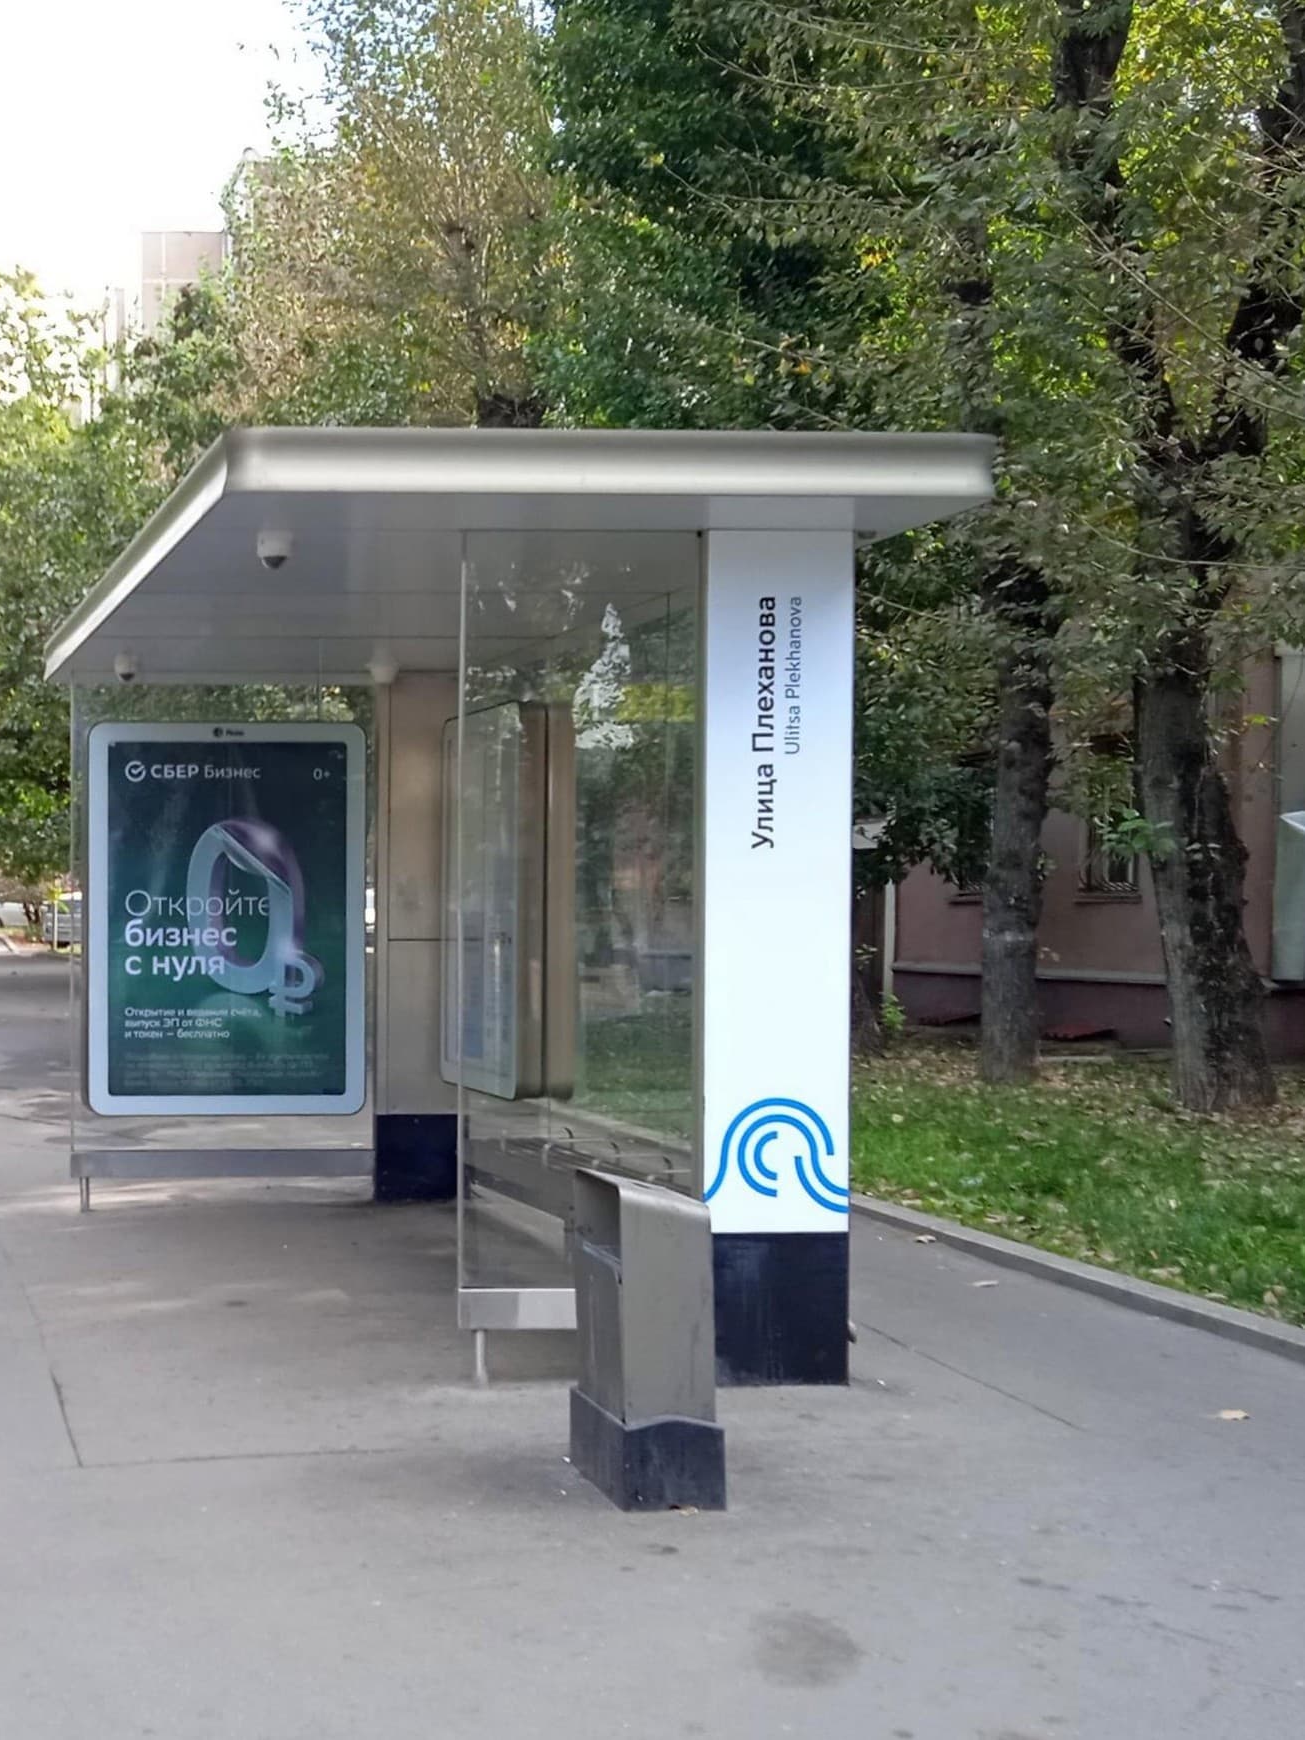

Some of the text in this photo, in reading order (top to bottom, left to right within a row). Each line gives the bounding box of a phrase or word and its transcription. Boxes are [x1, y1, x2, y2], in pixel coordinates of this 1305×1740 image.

[784, 596, 802, 754] Ulitsa Plekhanova
[751, 596, 777, 849] Улица Плеханова
[150, 764, 261, 779] СБЕР Бизнес
[313, 768, 331, 780] 0+
[125, 889, 270, 923] Откройте
[124, 918, 237, 946] бизнес
[124, 955, 225, 981] с нуля
[125, 1030, 132, 1038] и
[133, 1030, 164, 1038] токен
[176, 1028, 231, 1039] бесплатно
[163, 1018, 180, 1028] ЭП
[181, 1020, 193, 1028] от
[194, 1018, 223, 1028] ФНС
